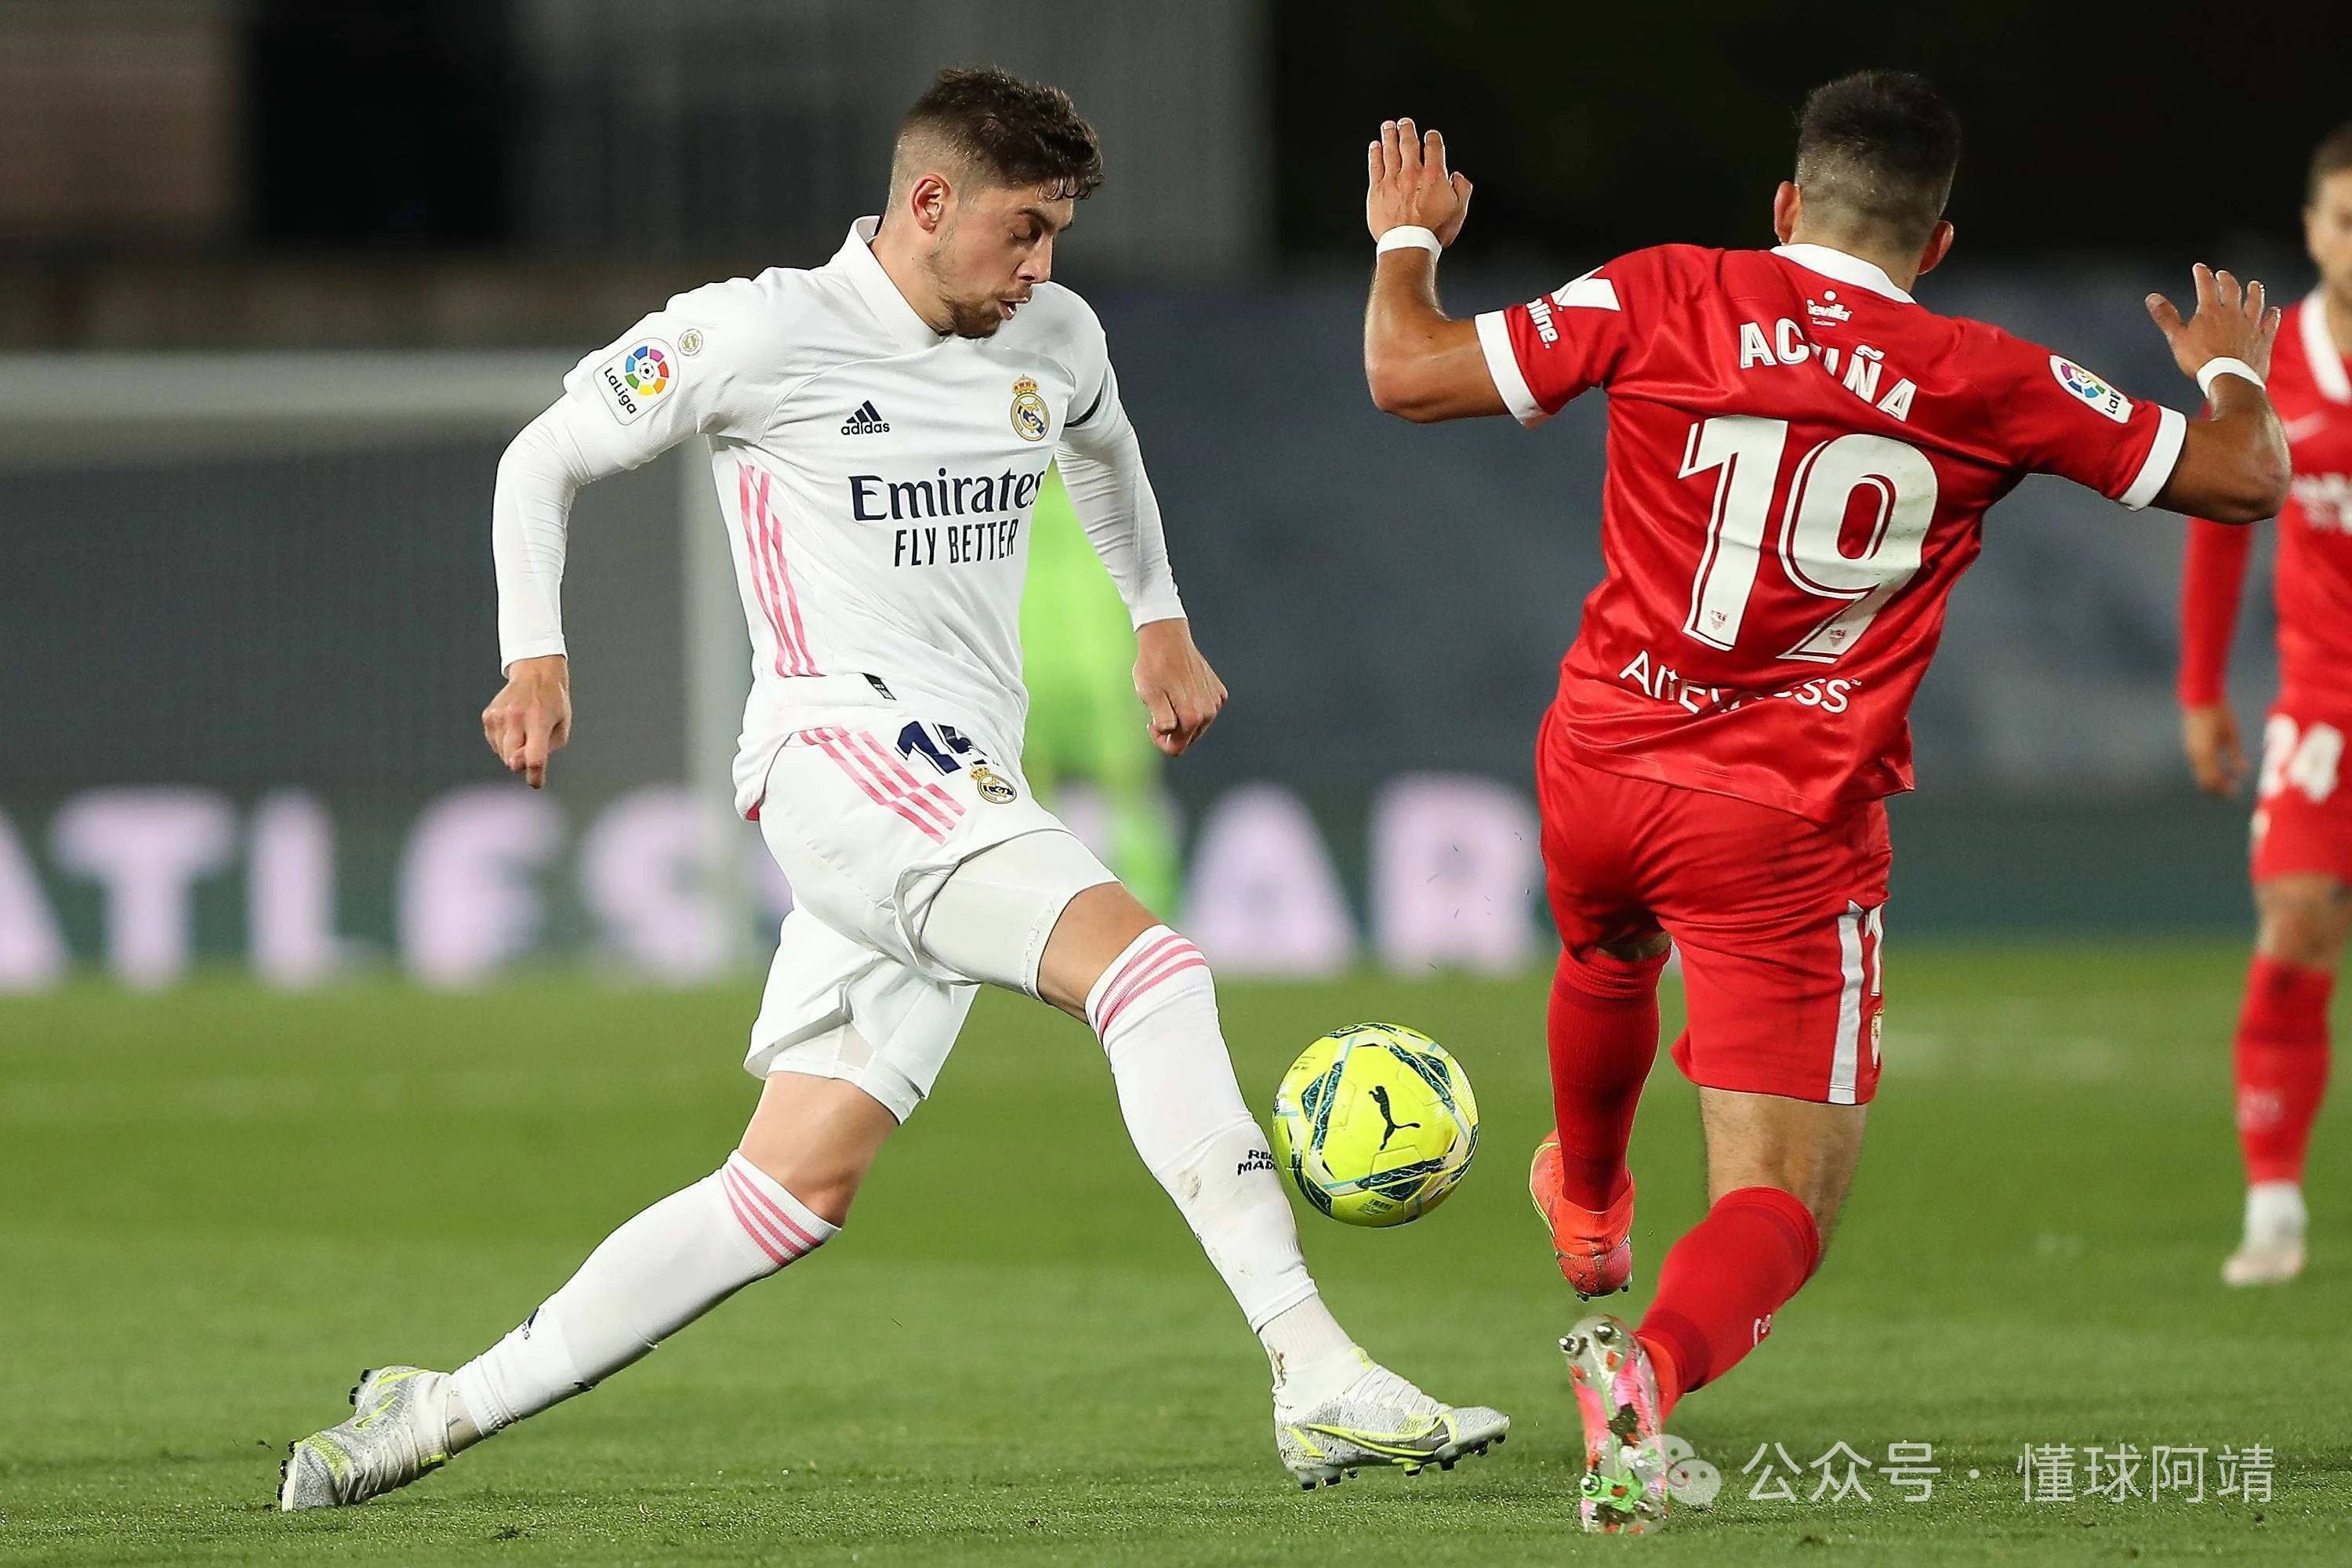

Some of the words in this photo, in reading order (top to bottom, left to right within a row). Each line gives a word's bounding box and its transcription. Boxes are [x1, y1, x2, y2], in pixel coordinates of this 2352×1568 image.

[604, 367, 637, 414] LaLiga
[840, 420, 891, 436] adidas
[894, 528, 937, 567] FLY
[948, 518, 1019, 564] BETTER
[1677, 414, 1938, 663] 19
